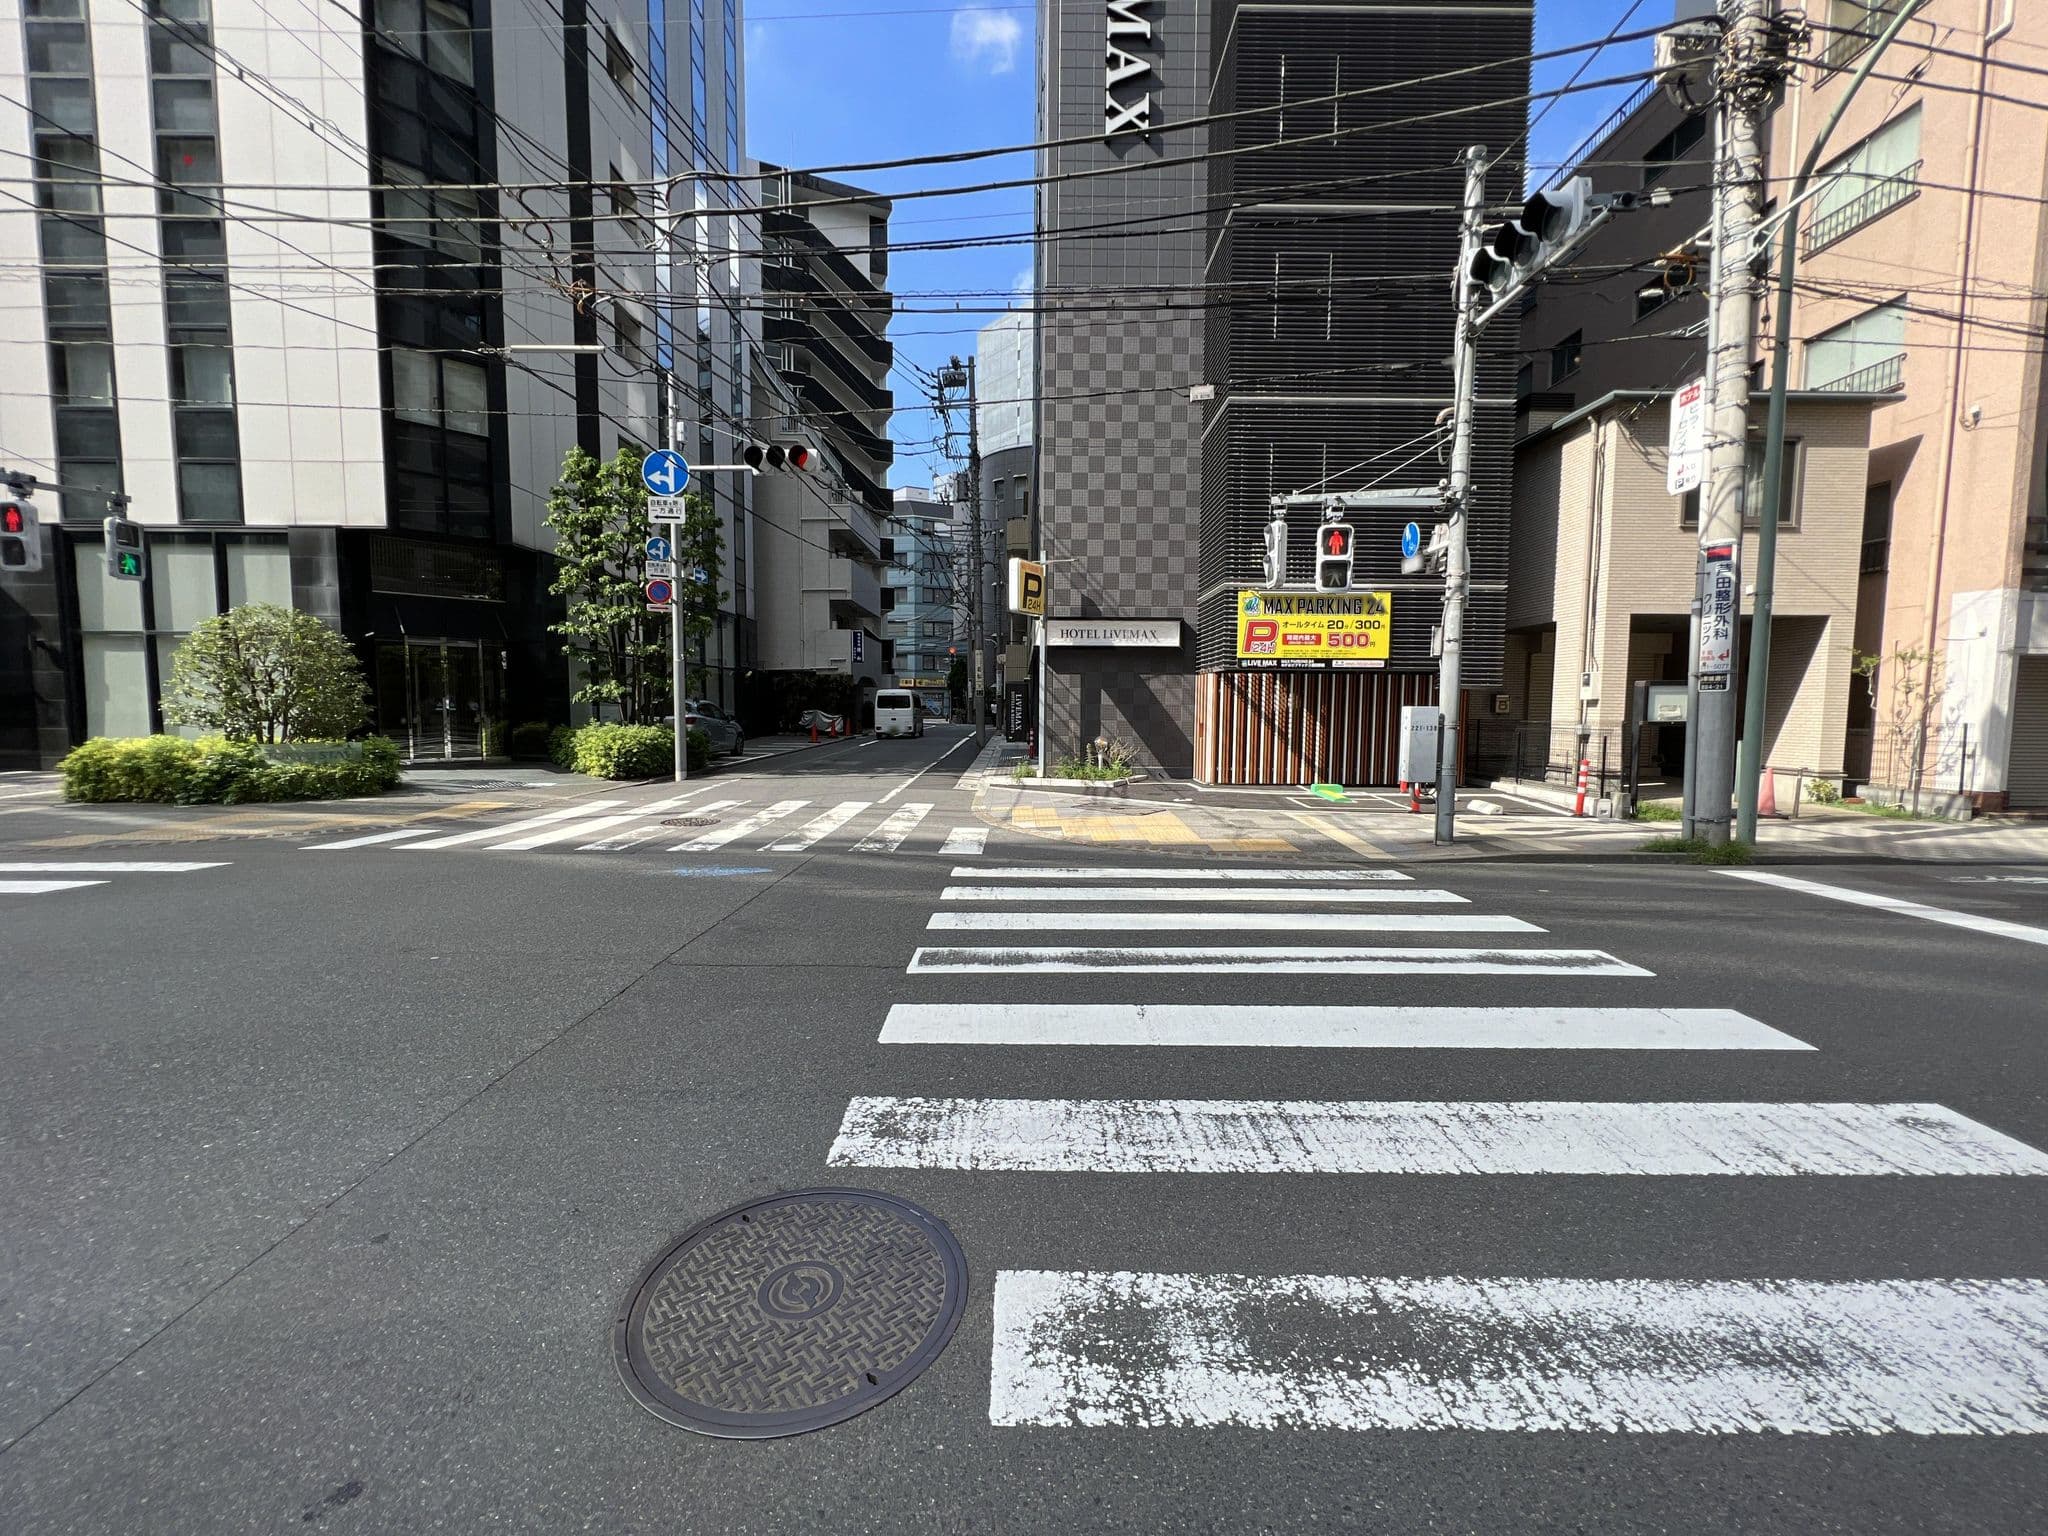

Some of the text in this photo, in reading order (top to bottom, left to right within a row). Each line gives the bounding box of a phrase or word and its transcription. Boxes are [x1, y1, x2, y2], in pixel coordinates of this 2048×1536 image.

[1028, 599, 1041, 610] 24H
[1263, 598, 1387, 615] MAX PARKING 24
[1712, 563, 1733, 641] 芦田整形外科
[1282, 621, 1325, 629] オールタイム
[1701, 593, 1712, 646] クリニック
[1060, 629, 1100, 640] HOTEL
